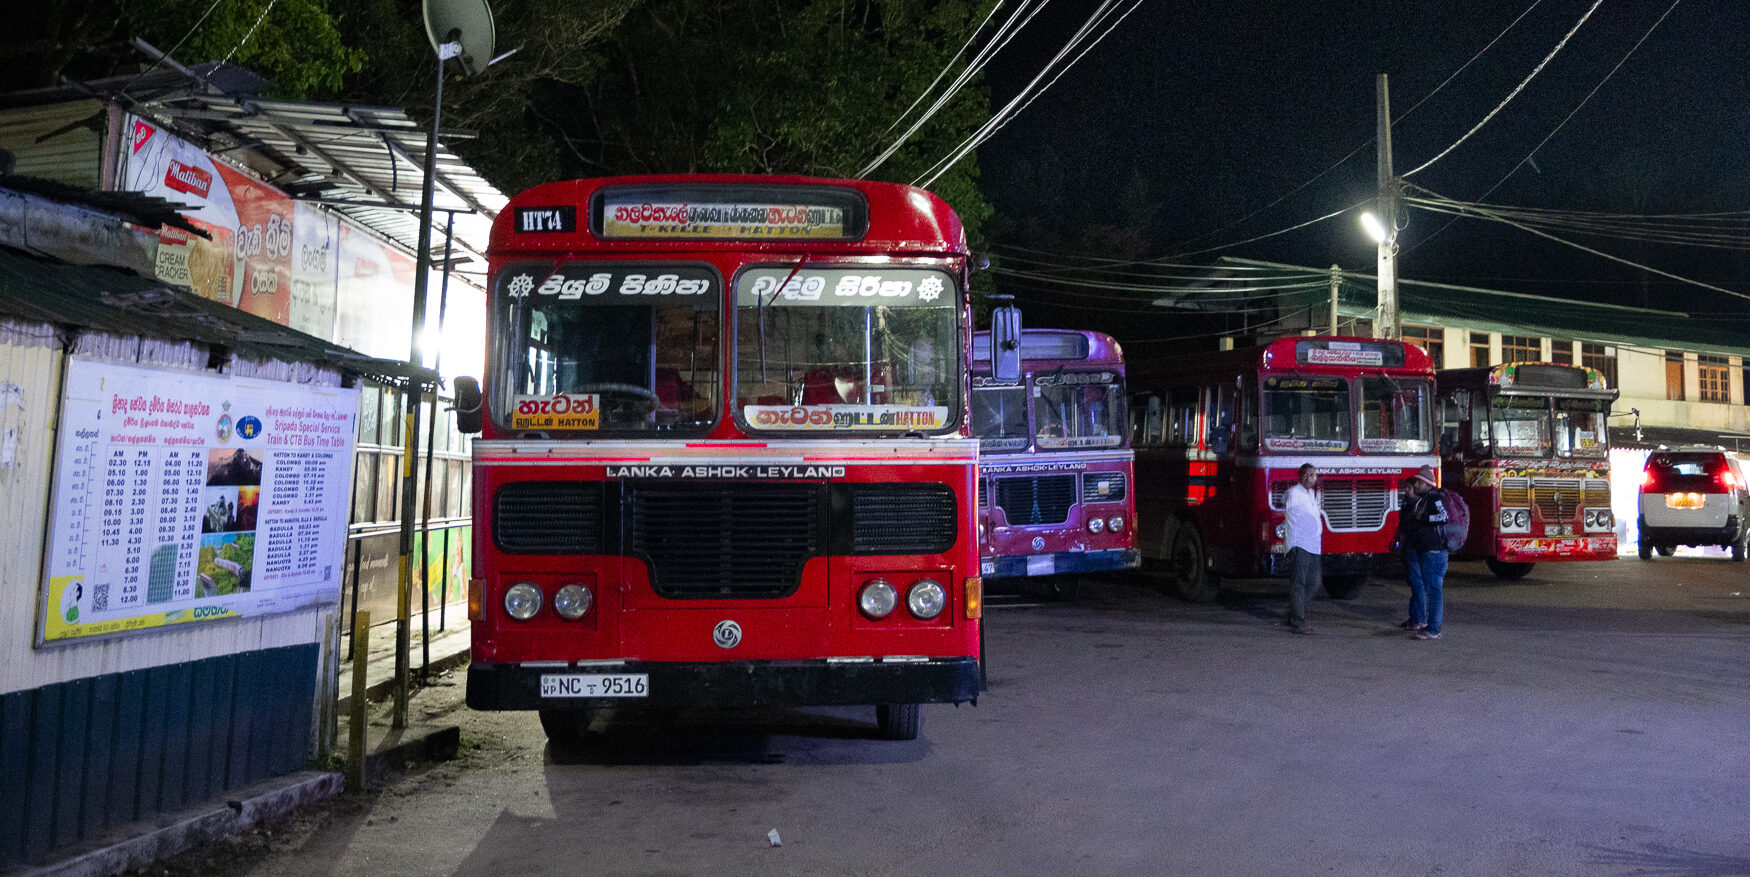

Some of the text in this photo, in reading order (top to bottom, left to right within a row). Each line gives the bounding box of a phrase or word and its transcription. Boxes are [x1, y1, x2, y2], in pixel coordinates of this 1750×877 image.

[171, 159, 208, 191] Maliban
[522, 210, 562, 230] HT74
[161, 224, 187, 241] Maliban
[740, 226, 811, 235] HATTON
[159, 252, 185, 266] CREAM
[519, 395, 593, 415] හැටන්
[558, 418, 595, 427] HATTON
[896, 411, 935, 425] HATTON
[274, 420, 297, 433] Sripada
[299, 421, 319, 433] Special
[321, 422, 340, 433] Service
[267, 433, 344, 447] Train & CTB Bus Time Table
[606, 466, 846, 477] LANKA ASHOK LEYLAND
[129, 527, 142, 535] 4.00
[101, 538, 119, 546] 11.30
[158, 533, 194, 543] 10.30 4.45
[127, 546, 140, 554] 5.10
[126, 556, 140, 564] 6.00
[174, 588, 190, 596] 11.00
[121, 595, 138, 603] 12.00
[543, 677, 645, 695] WP NC 9516
